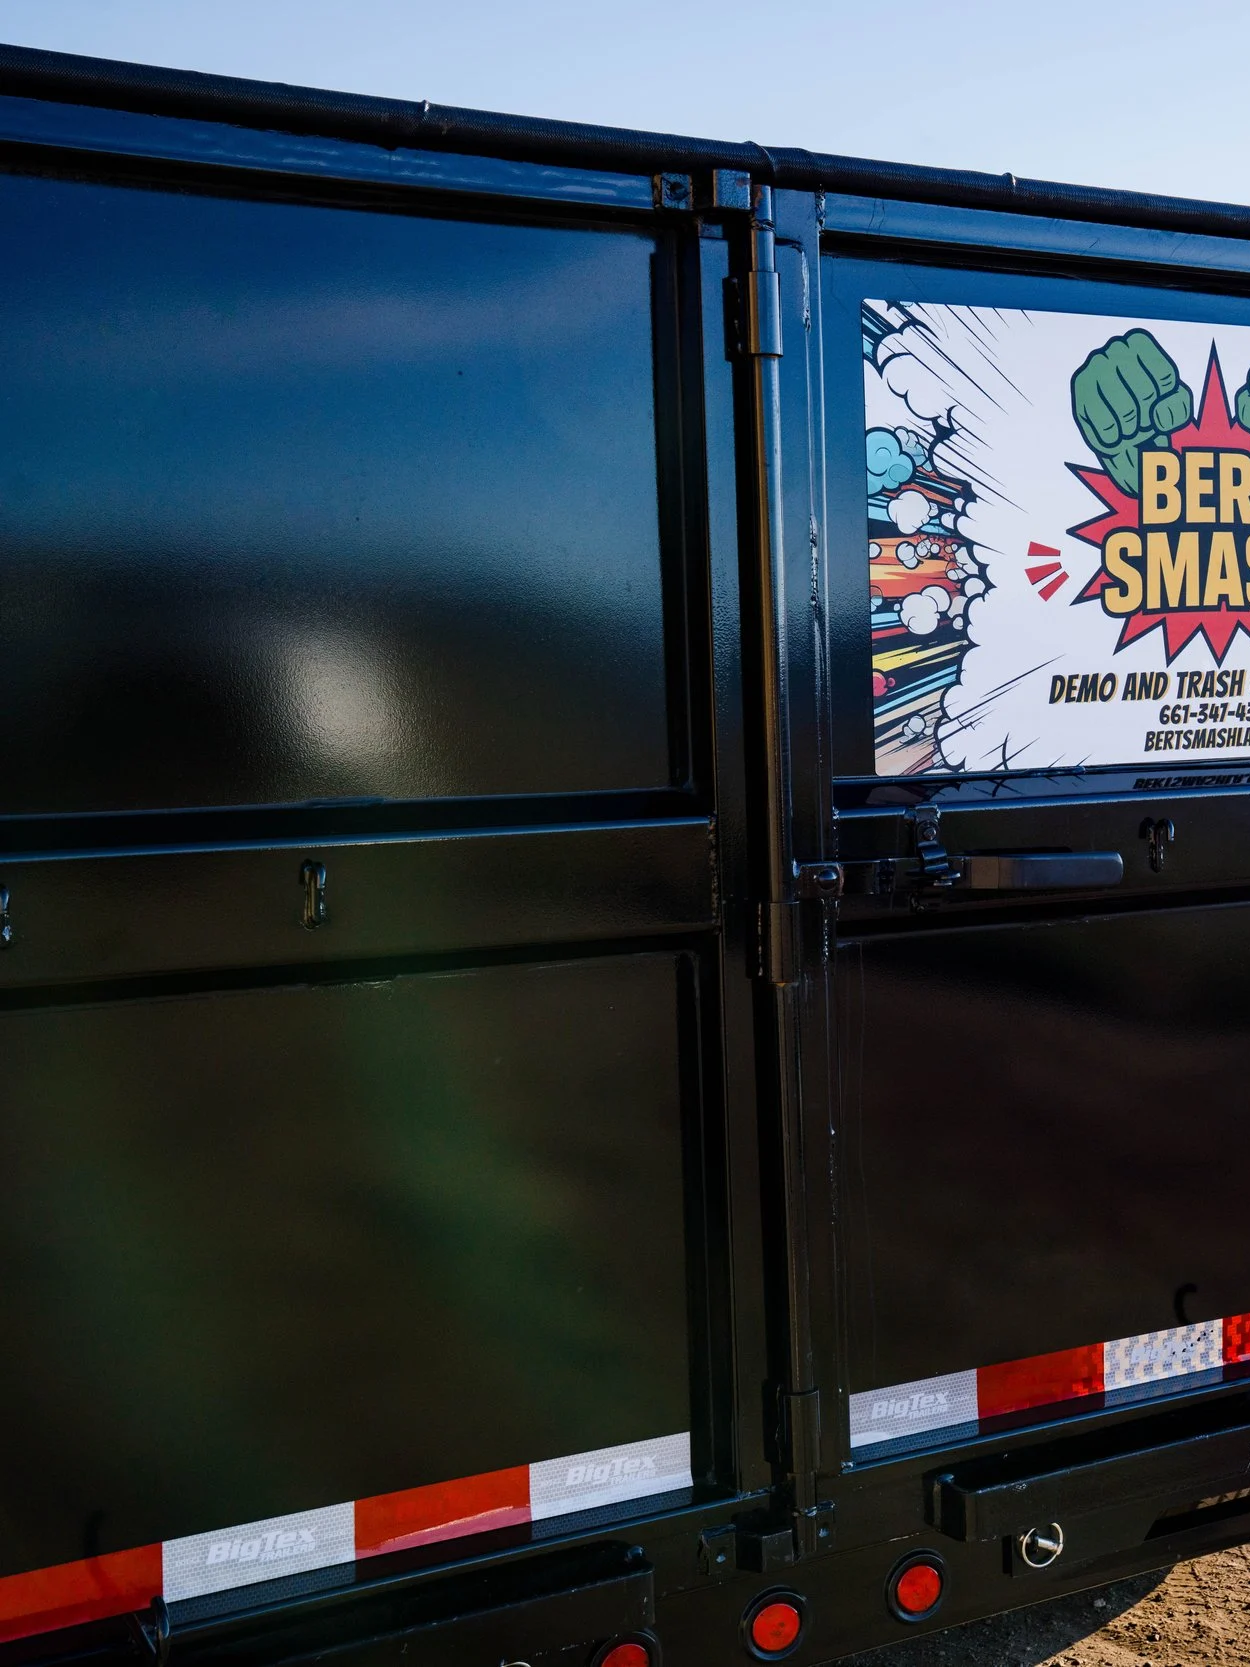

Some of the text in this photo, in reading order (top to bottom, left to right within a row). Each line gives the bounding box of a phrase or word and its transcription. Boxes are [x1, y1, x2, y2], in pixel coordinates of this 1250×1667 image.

[1048, 672, 1118, 704] DEMO
[1121, 671, 1170, 701] AND
[1176, 669, 1246, 699] TRASH
